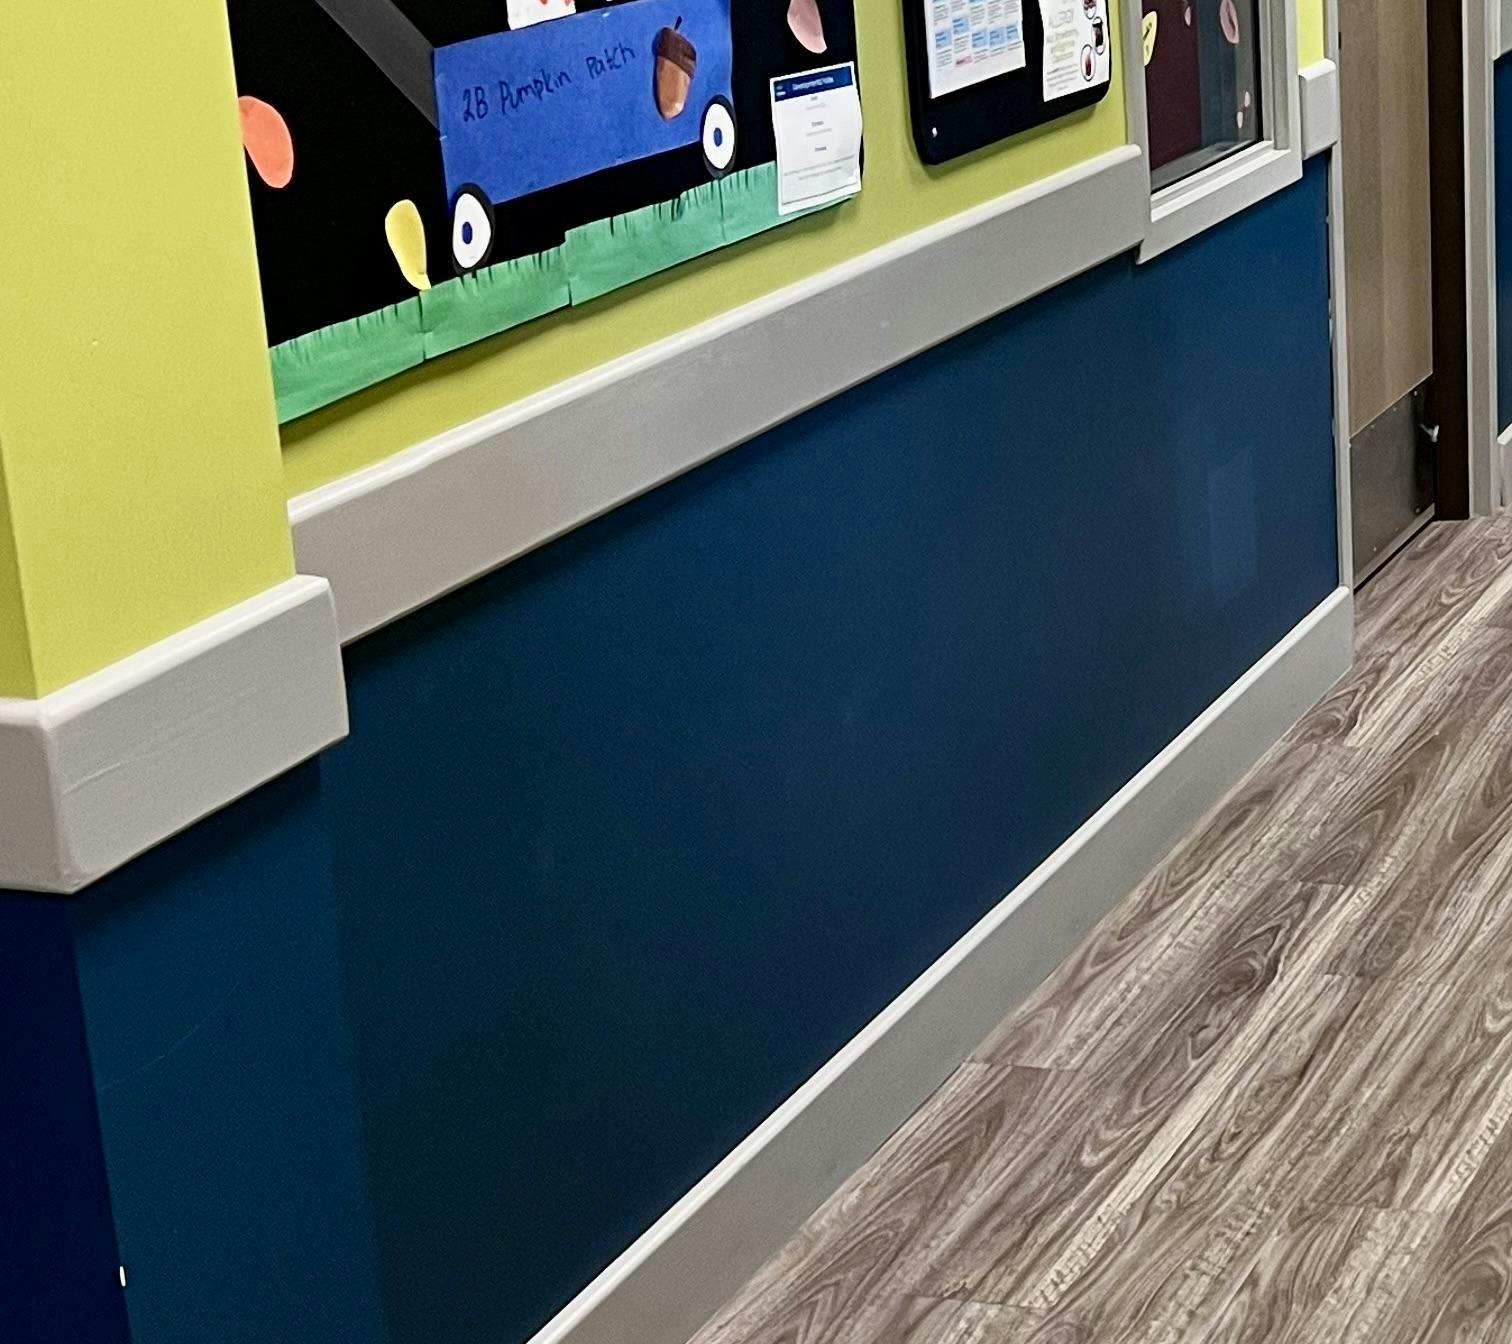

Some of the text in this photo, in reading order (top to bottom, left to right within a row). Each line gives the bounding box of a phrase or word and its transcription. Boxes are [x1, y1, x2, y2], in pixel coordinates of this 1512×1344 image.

[462, 42, 637, 122] 2B Pumpkin Patch
